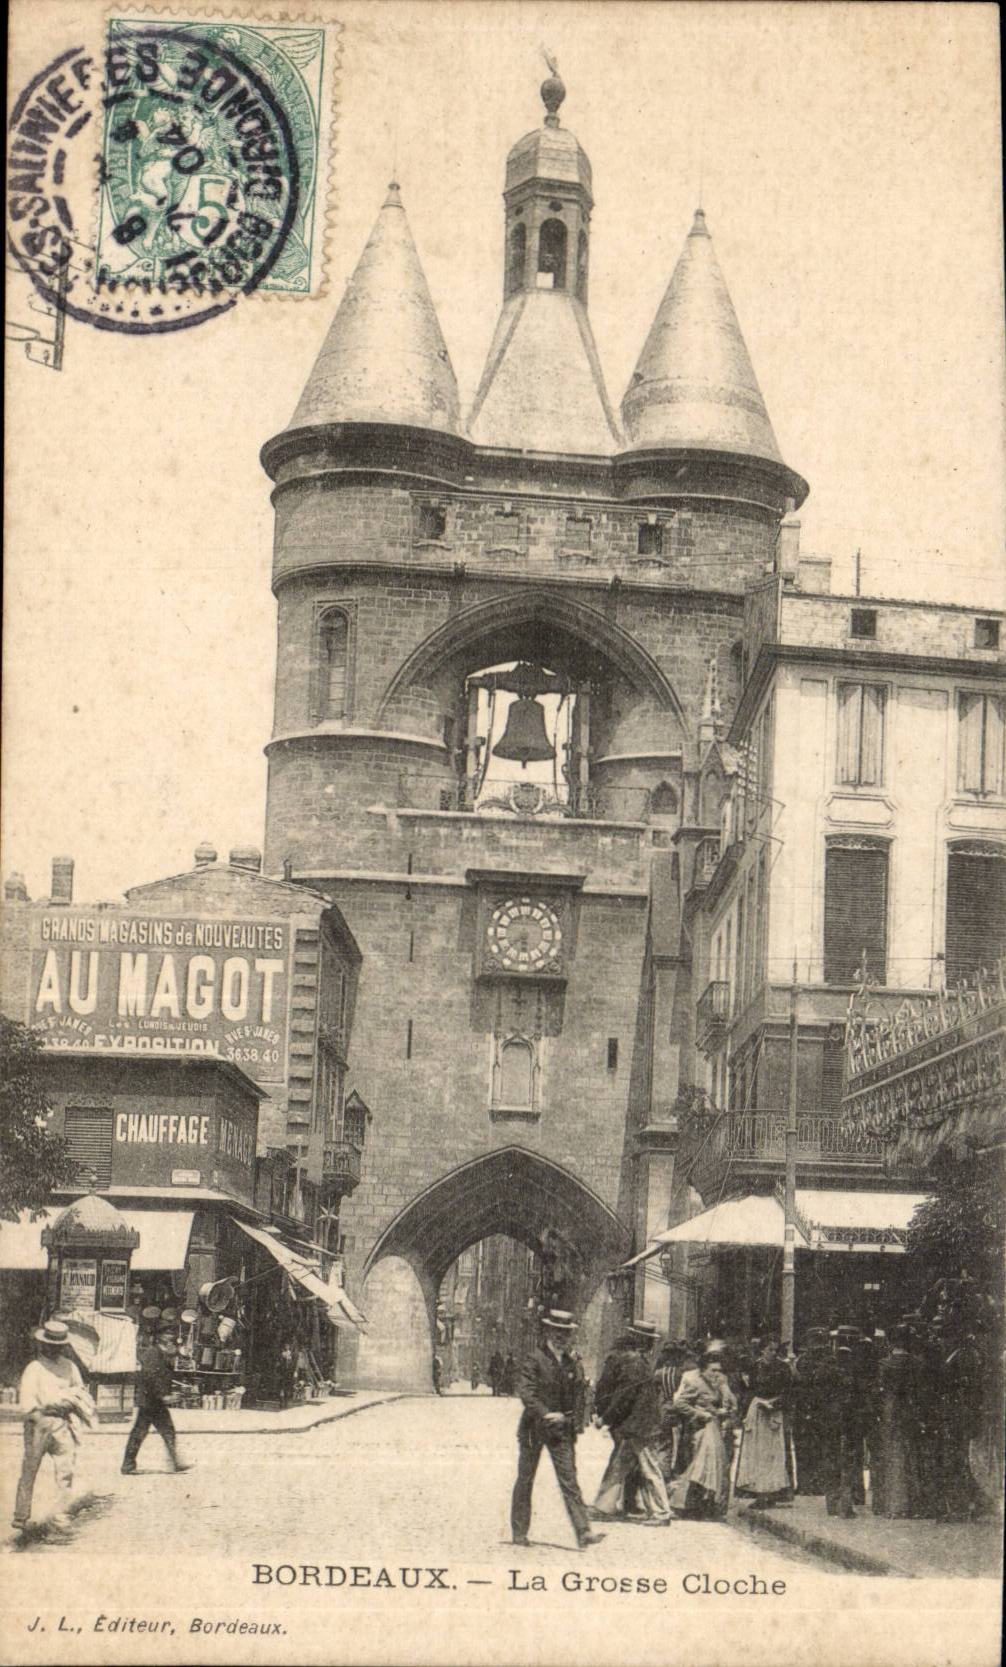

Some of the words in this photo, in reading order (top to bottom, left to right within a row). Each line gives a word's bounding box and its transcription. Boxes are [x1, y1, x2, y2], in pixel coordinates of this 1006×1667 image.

[41, 917, 95, 942] GRANDS
[99, 919, 172, 946] MAGASINS
[175, 925, 192, 946] de
[35, 949, 99, 1016] AU
[117, 952, 284, 1023] MAGOT
[116, 1113, 210, 1144] CHAUFFAGE
